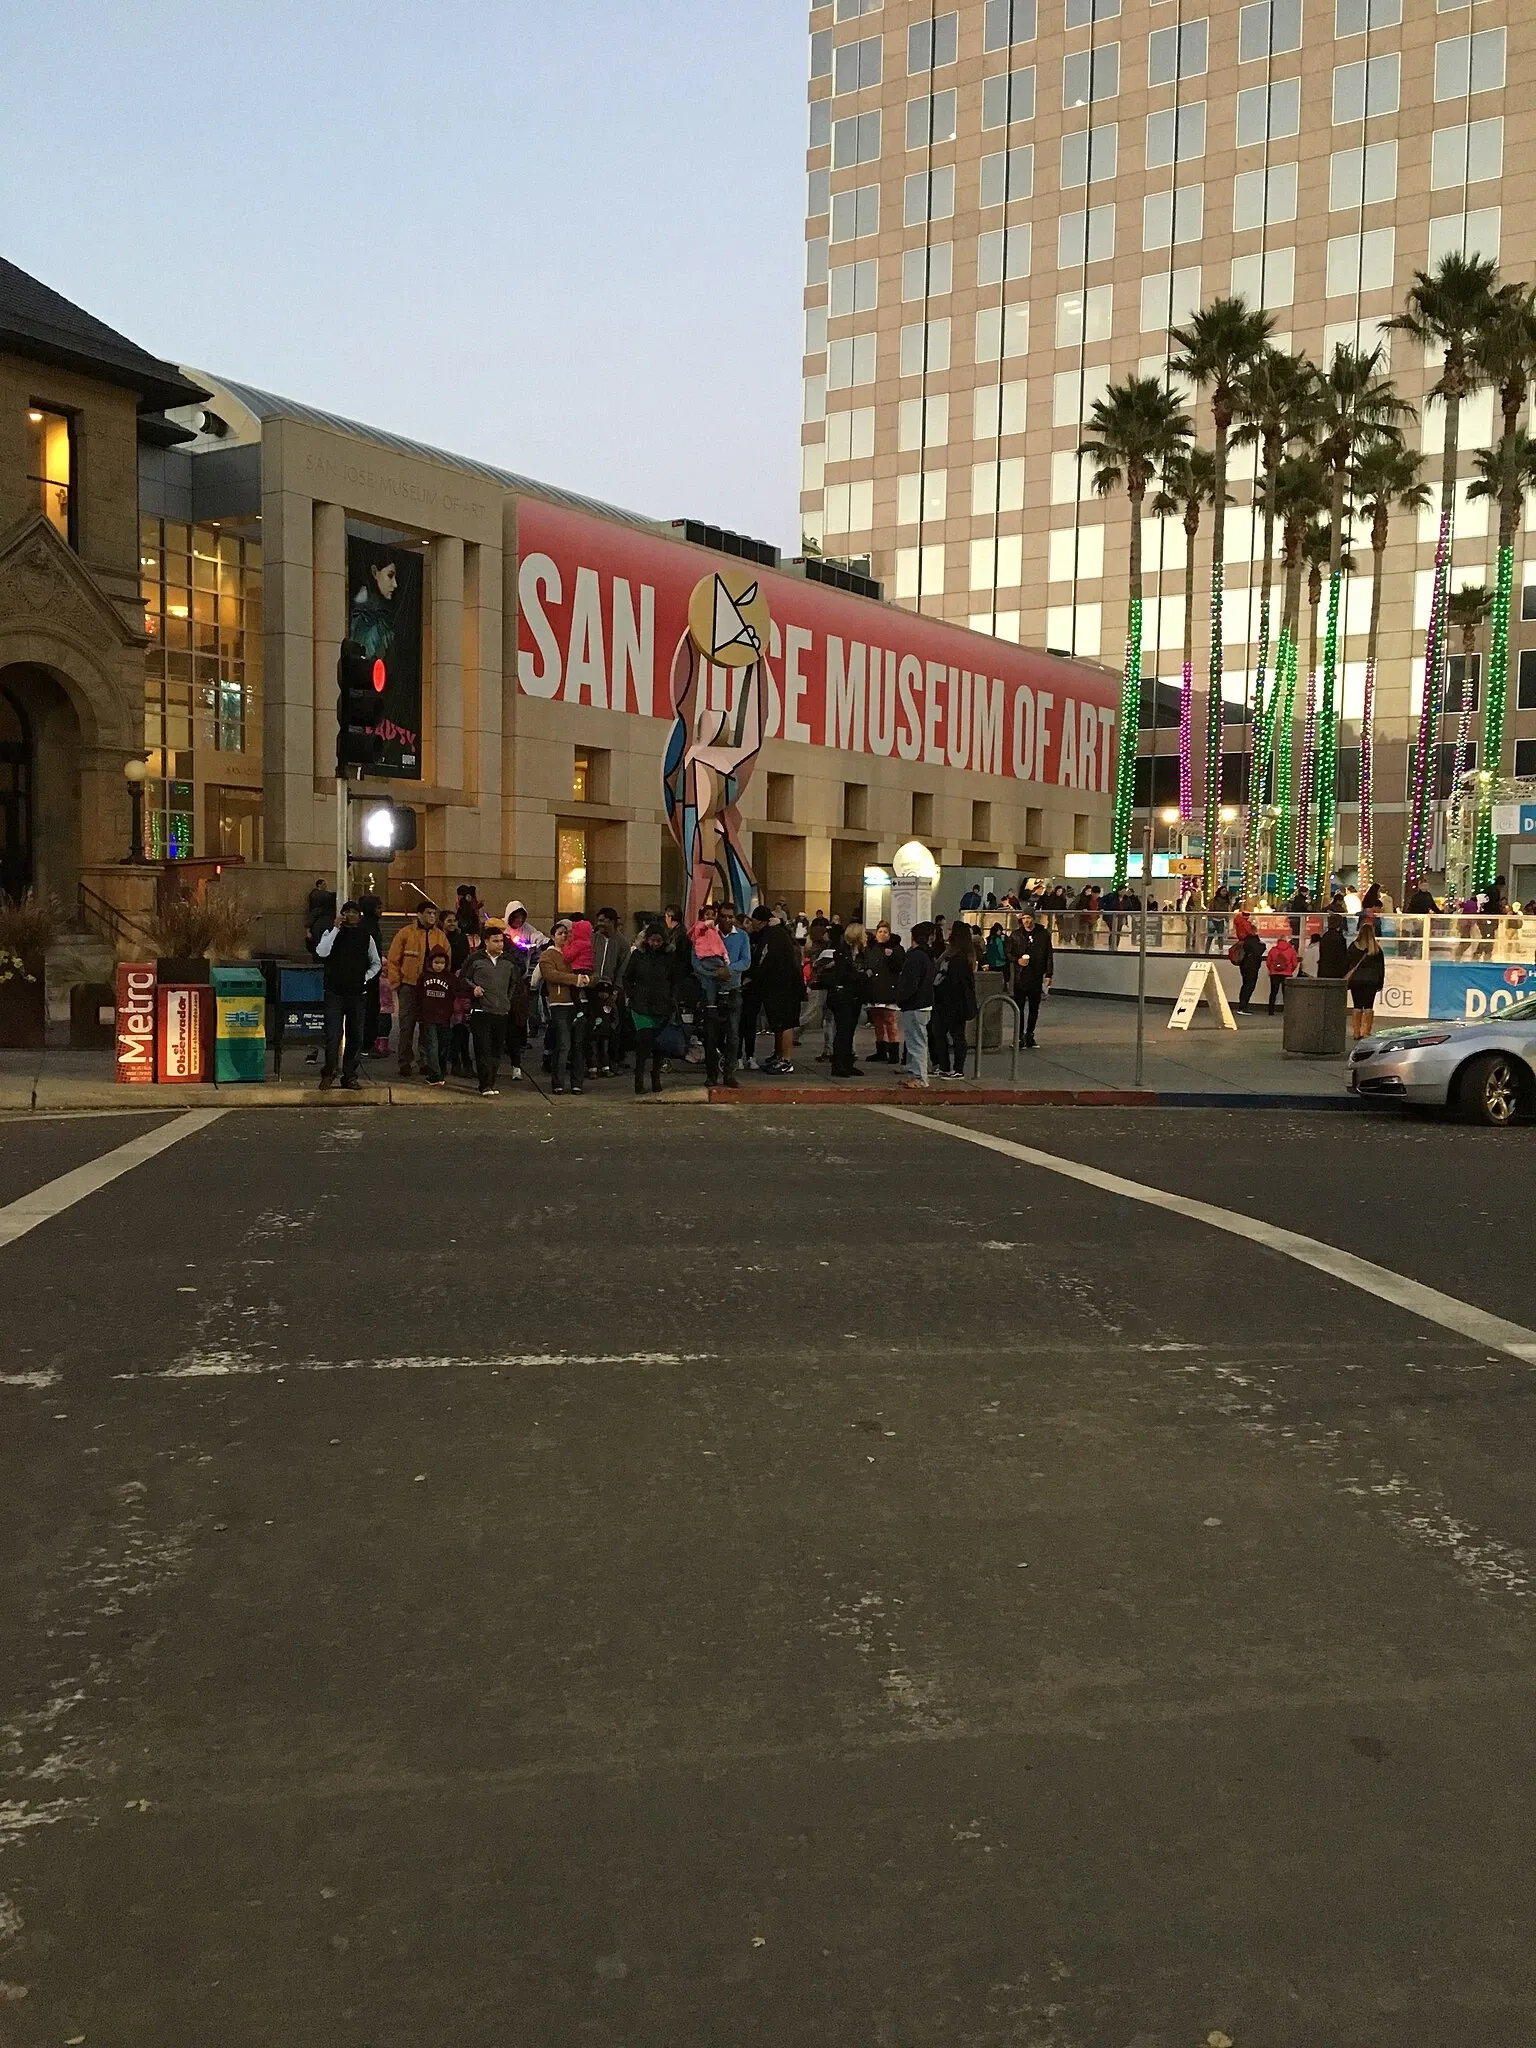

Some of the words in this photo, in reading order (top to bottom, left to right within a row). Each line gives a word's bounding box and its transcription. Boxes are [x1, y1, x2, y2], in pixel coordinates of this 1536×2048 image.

[305, 453, 336, 476] SAN
[344, 463, 376, 490] JOSE
[379, 475, 437, 505] MUSEUM
[442, 494, 460, 511] OF
[518, 552, 655, 717] SAN
[695, 616, 812, 743] OSE
[825, 634, 1004, 775] MUSEUM
[1013, 685, 1053, 782] OF
[1059, 698, 1115, 793] ART
[118, 972, 154, 1063] Metro
[1379, 987, 1413, 1009] ICE
[171, 1044, 179, 1055] el
[177, 996, 187, 1075] Observador
